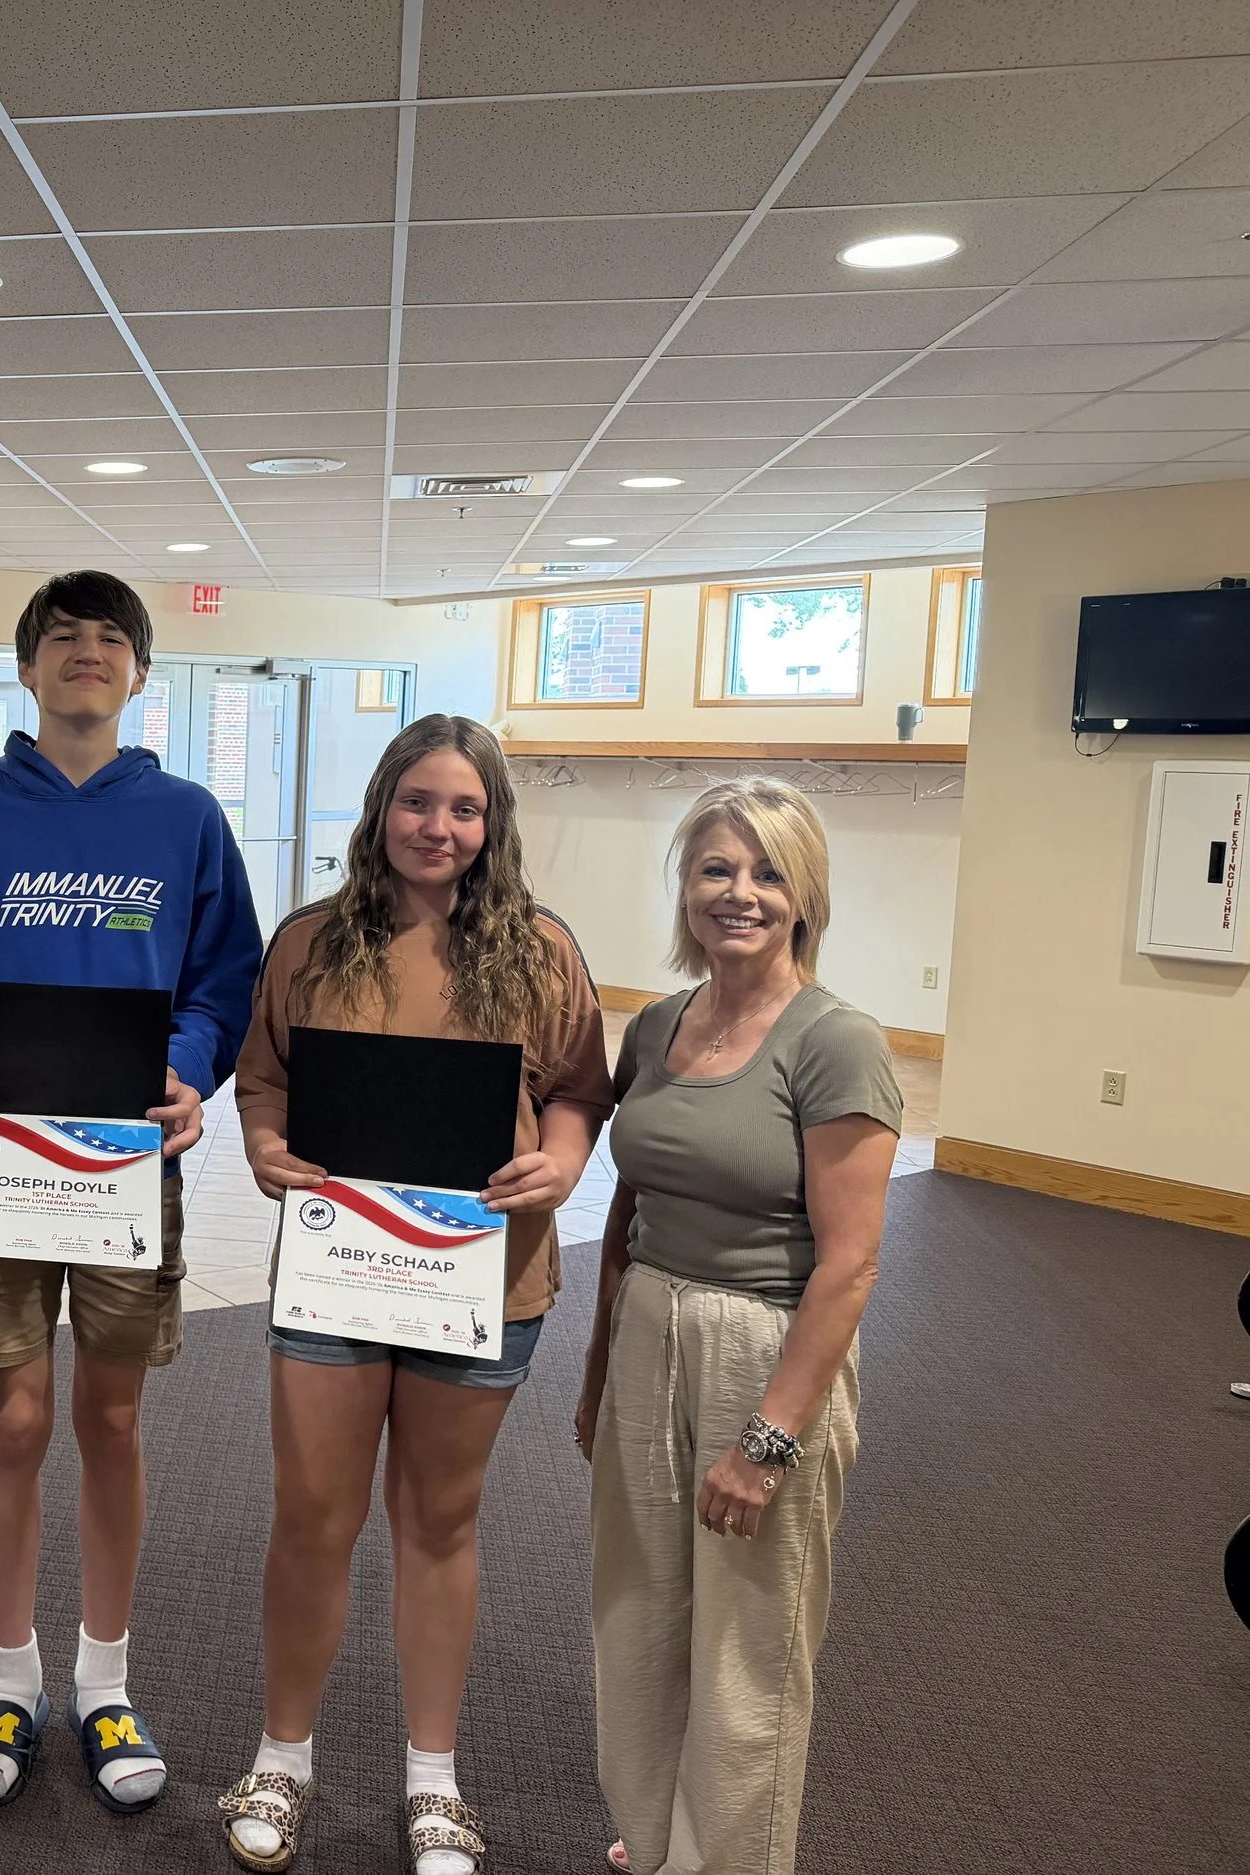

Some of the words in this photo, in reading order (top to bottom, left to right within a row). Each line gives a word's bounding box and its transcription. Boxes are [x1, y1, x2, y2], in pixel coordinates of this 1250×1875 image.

[193, 585, 221, 614] EXIT
[1233, 794, 1242, 826] FIRE
[5, 872, 164, 905] IMMANUEL
[1223, 831, 1239, 929] EXTINGUISHER
[0, 902, 116, 927] TRINITY
[108, 916, 152, 928] ATHLETICS
[61, 1181, 117, 1194] DOYLE
[327, 1246, 376, 1263] ABBY
[380, 1253, 455, 1274] SCHAAP
[367, 1265, 384, 1273] 3RD
[385, 1268, 413, 1277] PLACE
[341, 1270, 367, 1278] TRINITY
[369, 1274, 407, 1284] LUTHERAN
[409, 1279, 438, 1288] SCHOOL
[95, 1714, 144, 1750] M
